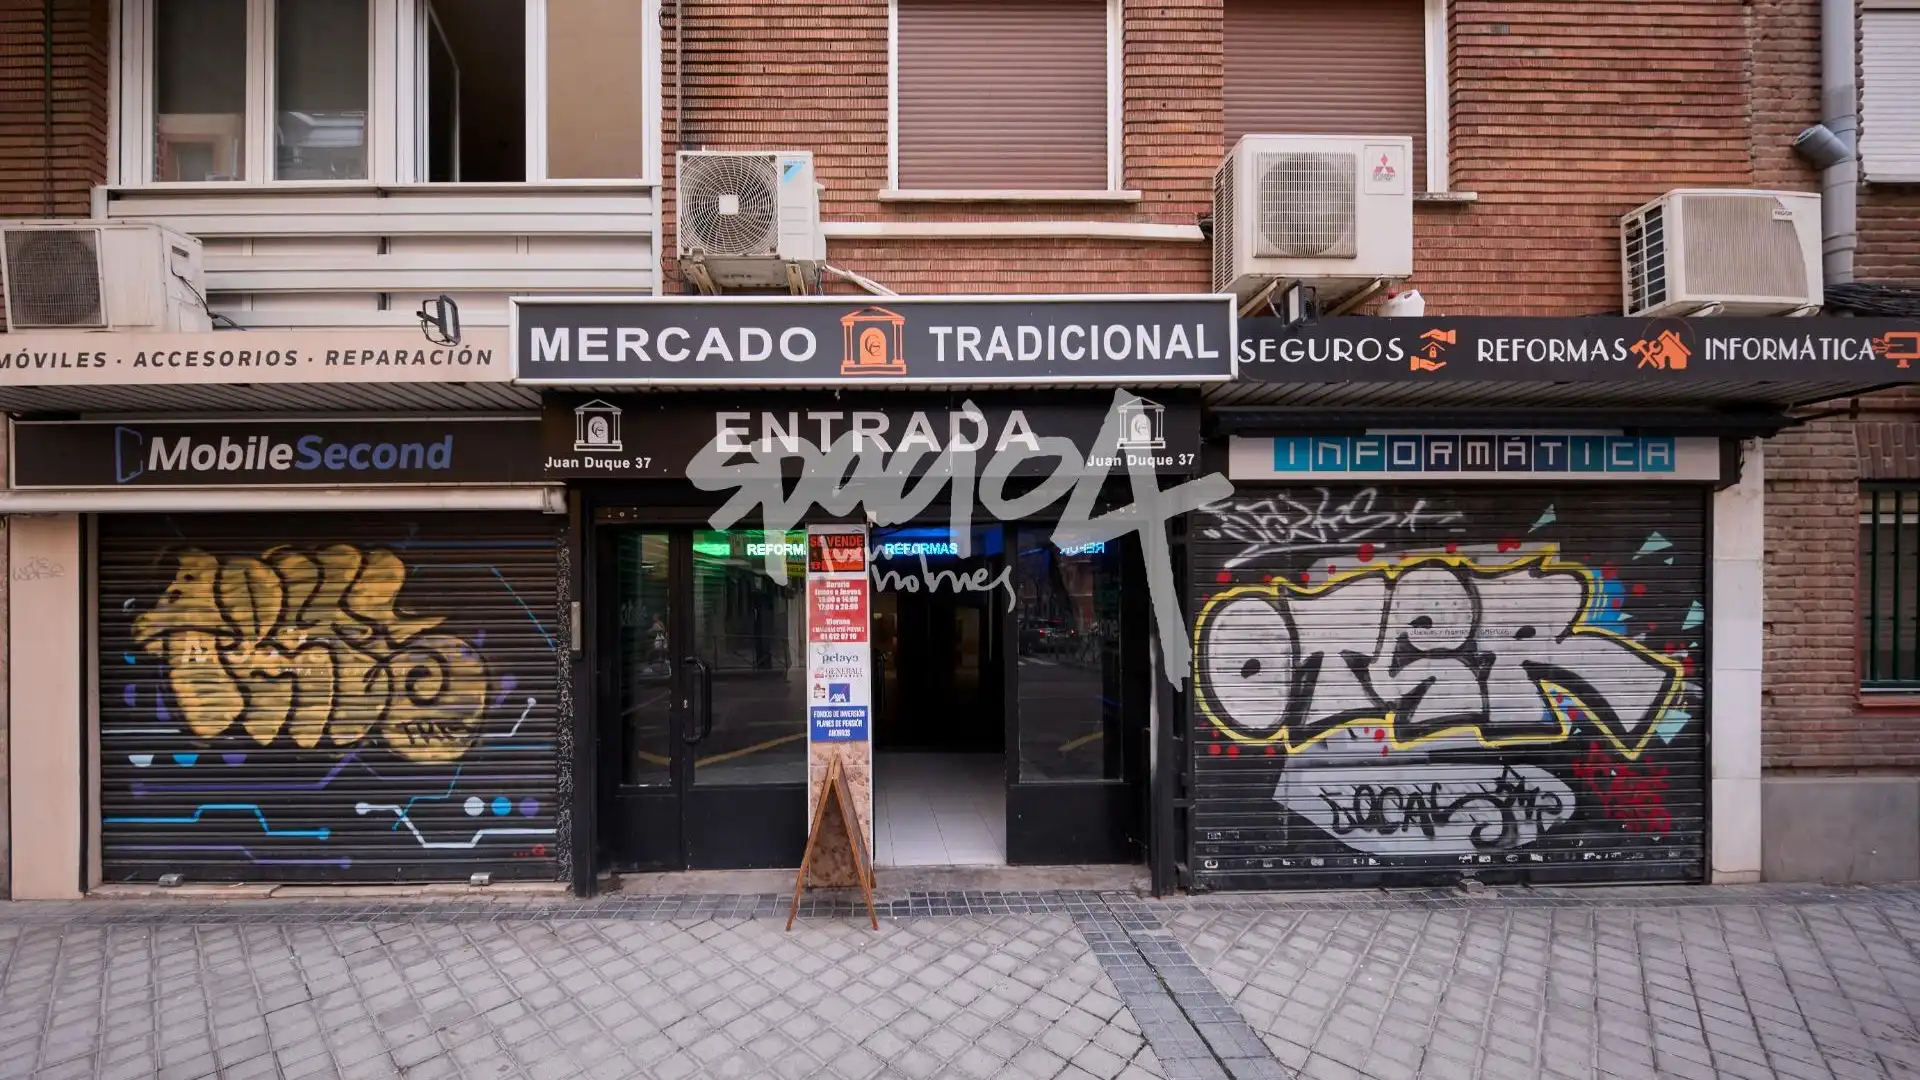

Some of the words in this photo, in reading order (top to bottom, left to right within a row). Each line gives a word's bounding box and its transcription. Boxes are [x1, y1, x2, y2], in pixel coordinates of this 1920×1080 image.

[530, 326, 818, 363] MERCADO
[929, 324, 1219, 362] TRADICIONAL
[1238, 336, 1404, 364] SEGUROS
[1477, 337, 1629, 363] REFORMAS
[1704, 333, 1876, 362] INFORMÁTICA
[133, 350, 299, 369] ACCESORIOS
[324, 345, 493, 367] REPARACIÓN
[715, 409, 1040, 453] ENTRADA
[148, 434, 454, 472] MobileSecond
[545, 456, 579, 469] Juan
[584, 456, 631, 472] Duque
[635, 457, 652, 469] 37
[1087, 454, 1122, 467] Juan
[1127, 453, 1174, 469] Duque
[1178, 453, 1195, 466] 37
[746, 543, 807, 556] REFORM
[826, 535, 864, 547] VENDE
[884, 542, 958, 556] REFORMAS
[822, 652, 859, 664] pelayo
[829, 693, 847, 702] AXA
